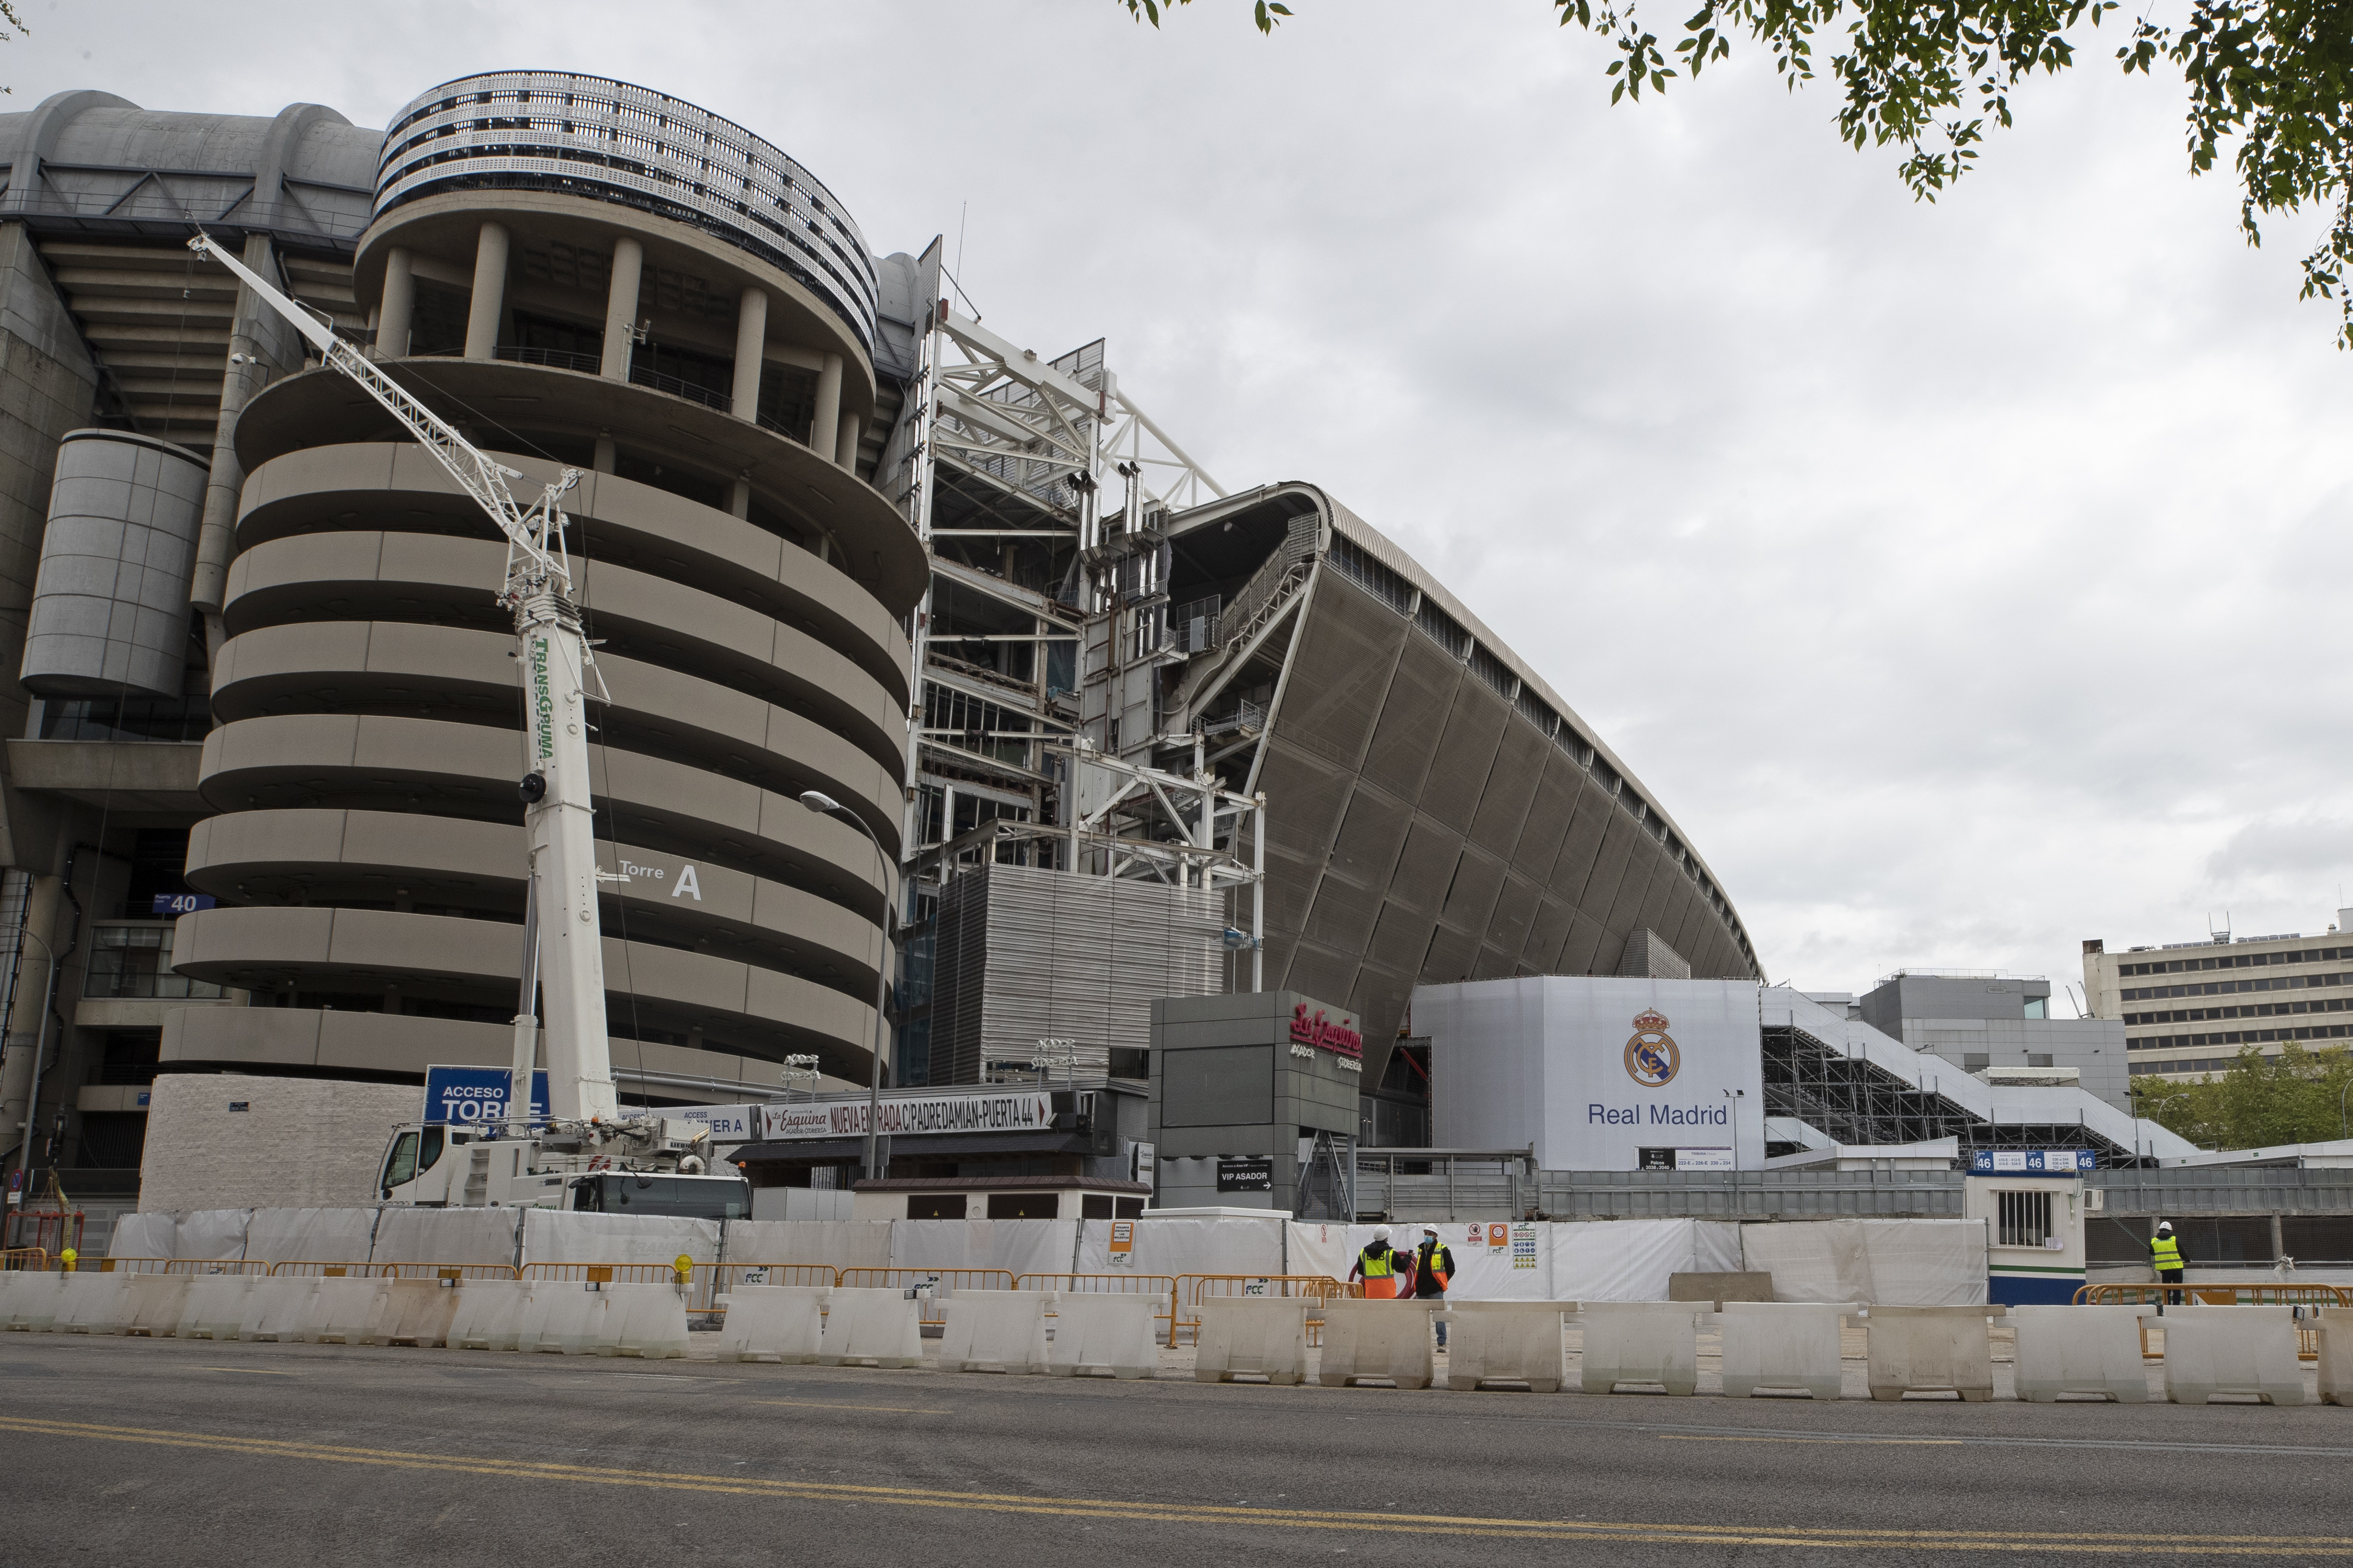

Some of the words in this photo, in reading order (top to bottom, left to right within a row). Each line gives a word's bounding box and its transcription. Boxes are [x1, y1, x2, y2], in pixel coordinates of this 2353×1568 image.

[535, 638, 554, 759] TRANSGRUMA
[619, 859, 664, 879] Torre
[671, 864, 702, 901] A
[171, 895, 197, 912] 40
[1312, 1009, 1363, 1052] Esquina
[1290, 1044, 1316, 1059] ASADOR
[443, 1086, 504, 1098] ACCESO
[772, 1112, 781, 1120] La
[780, 1110, 827, 1131] Esquina
[830, 1105, 860, 1134] NUEVA
[861, 1103, 902, 1133] ENRADA
[1022, 1098, 1033, 1127] 44
[1588, 1103, 1640, 1124] Real
[1650, 1104, 1727, 1125] Madrid
[734, 1119, 743, 1132] A
[1978, 1158, 1991, 1169] 46
[2028, 1158, 2042, 1168] 46
[2079, 1157, 2092, 1168] 46
[1235, 1172, 1267, 1180] ASADOR
[746, 1273, 763, 1283] FCC
[1246, 1285, 1263, 1294] FCC
